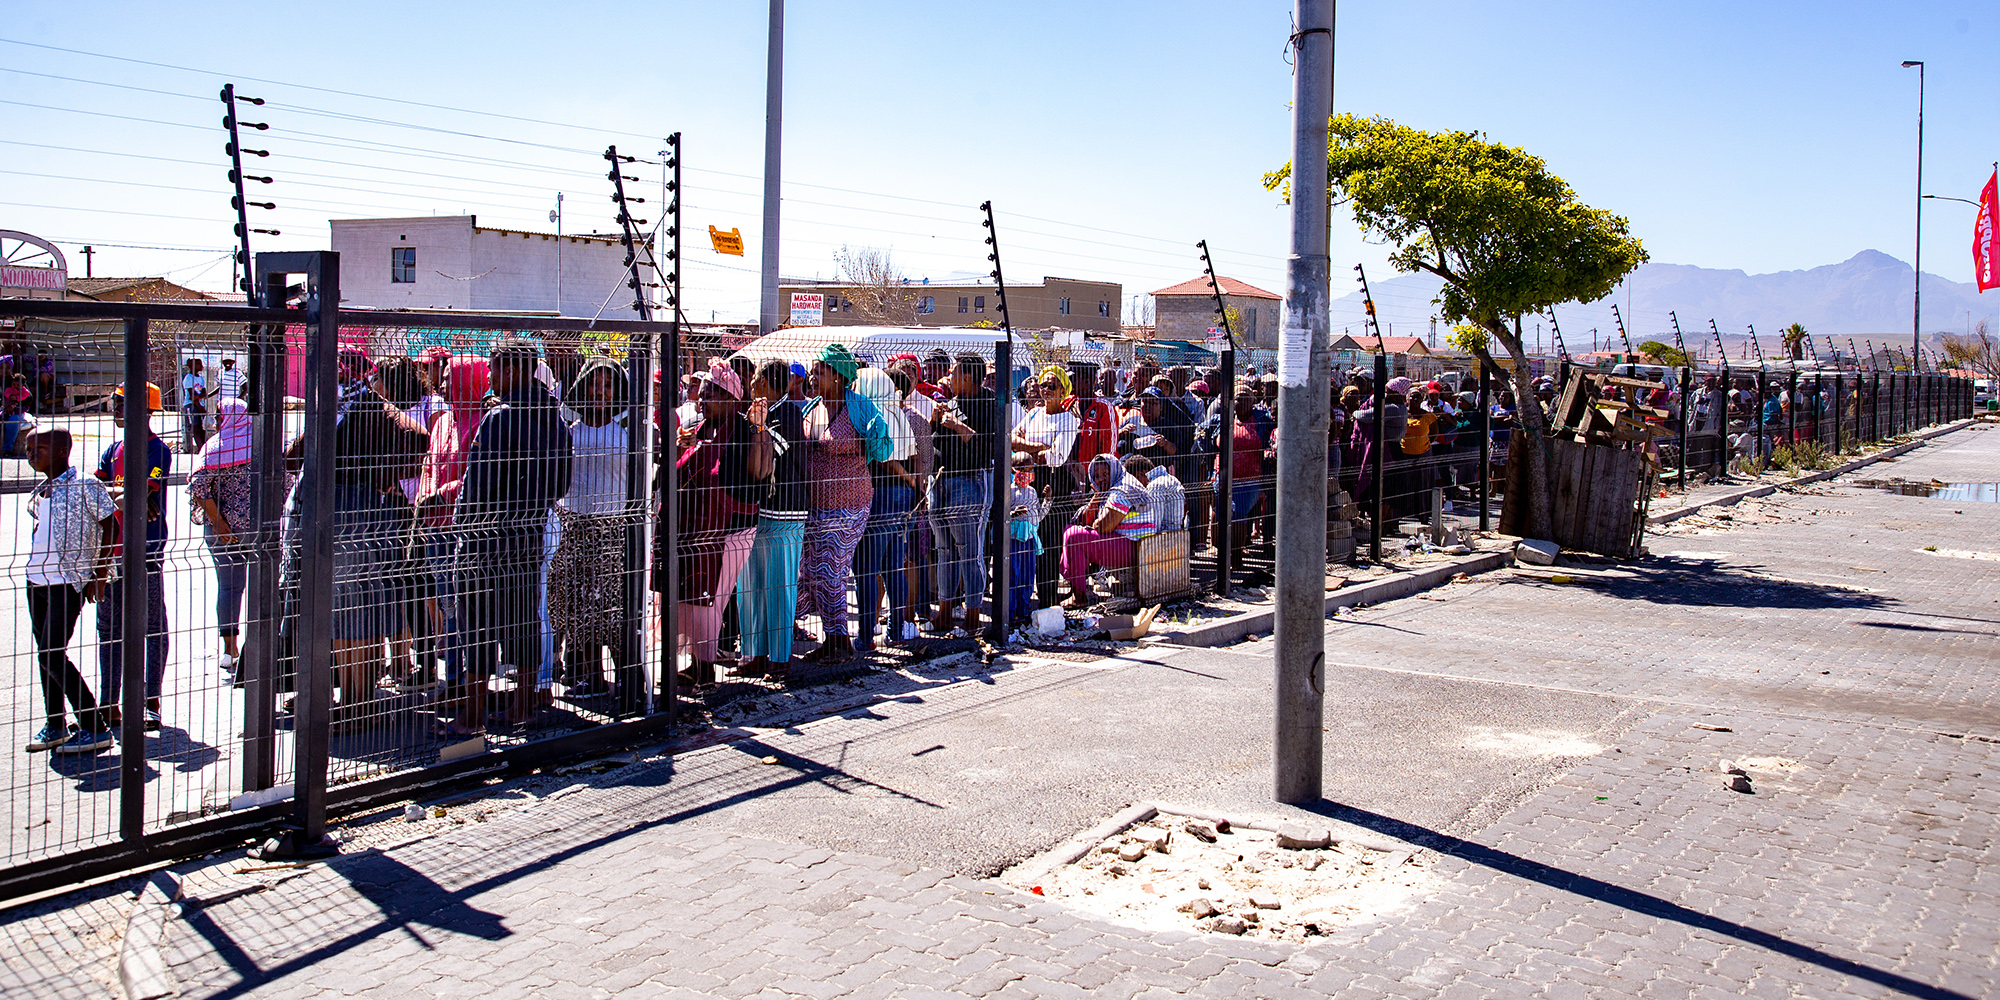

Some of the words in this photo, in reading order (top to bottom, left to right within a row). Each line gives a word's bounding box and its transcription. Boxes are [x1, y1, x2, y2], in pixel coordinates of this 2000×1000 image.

[1, 267, 65, 289] WOODWORKS
[794, 294, 822, 302] MASANDA
[791, 302, 822, 310] HARDWARE
